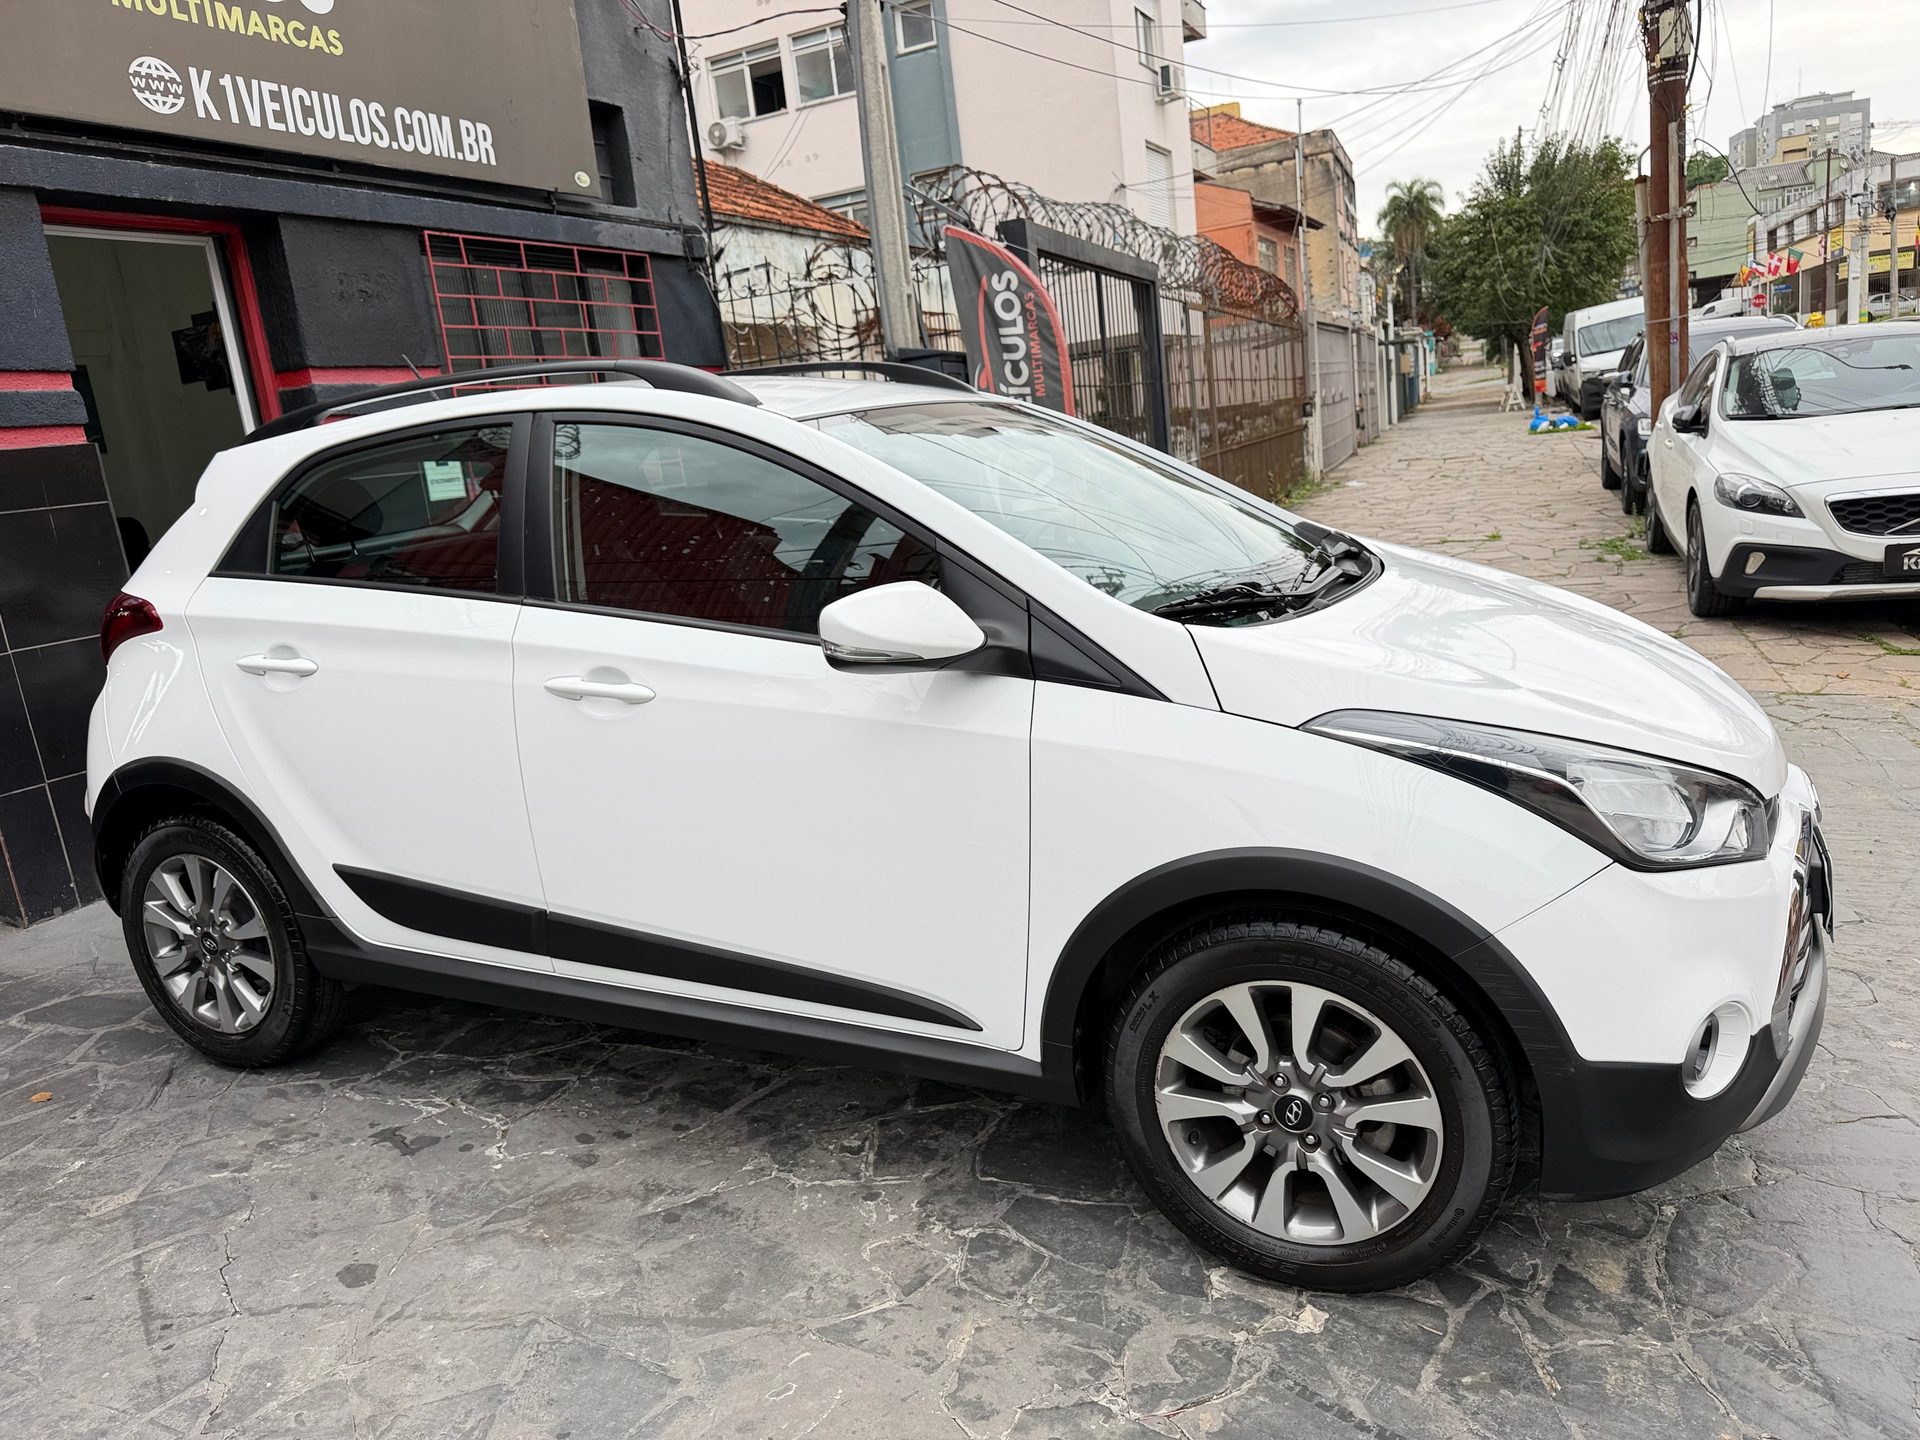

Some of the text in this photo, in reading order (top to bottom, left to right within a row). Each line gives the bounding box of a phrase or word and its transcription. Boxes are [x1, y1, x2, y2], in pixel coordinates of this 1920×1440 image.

[111, 0, 344, 56] ULTIMARCAS
[990, 269, 1033, 403] ÍCULOS
[1023, 291, 1046, 398] MULTIMARCAS
[1902, 555, 1920, 571] K
